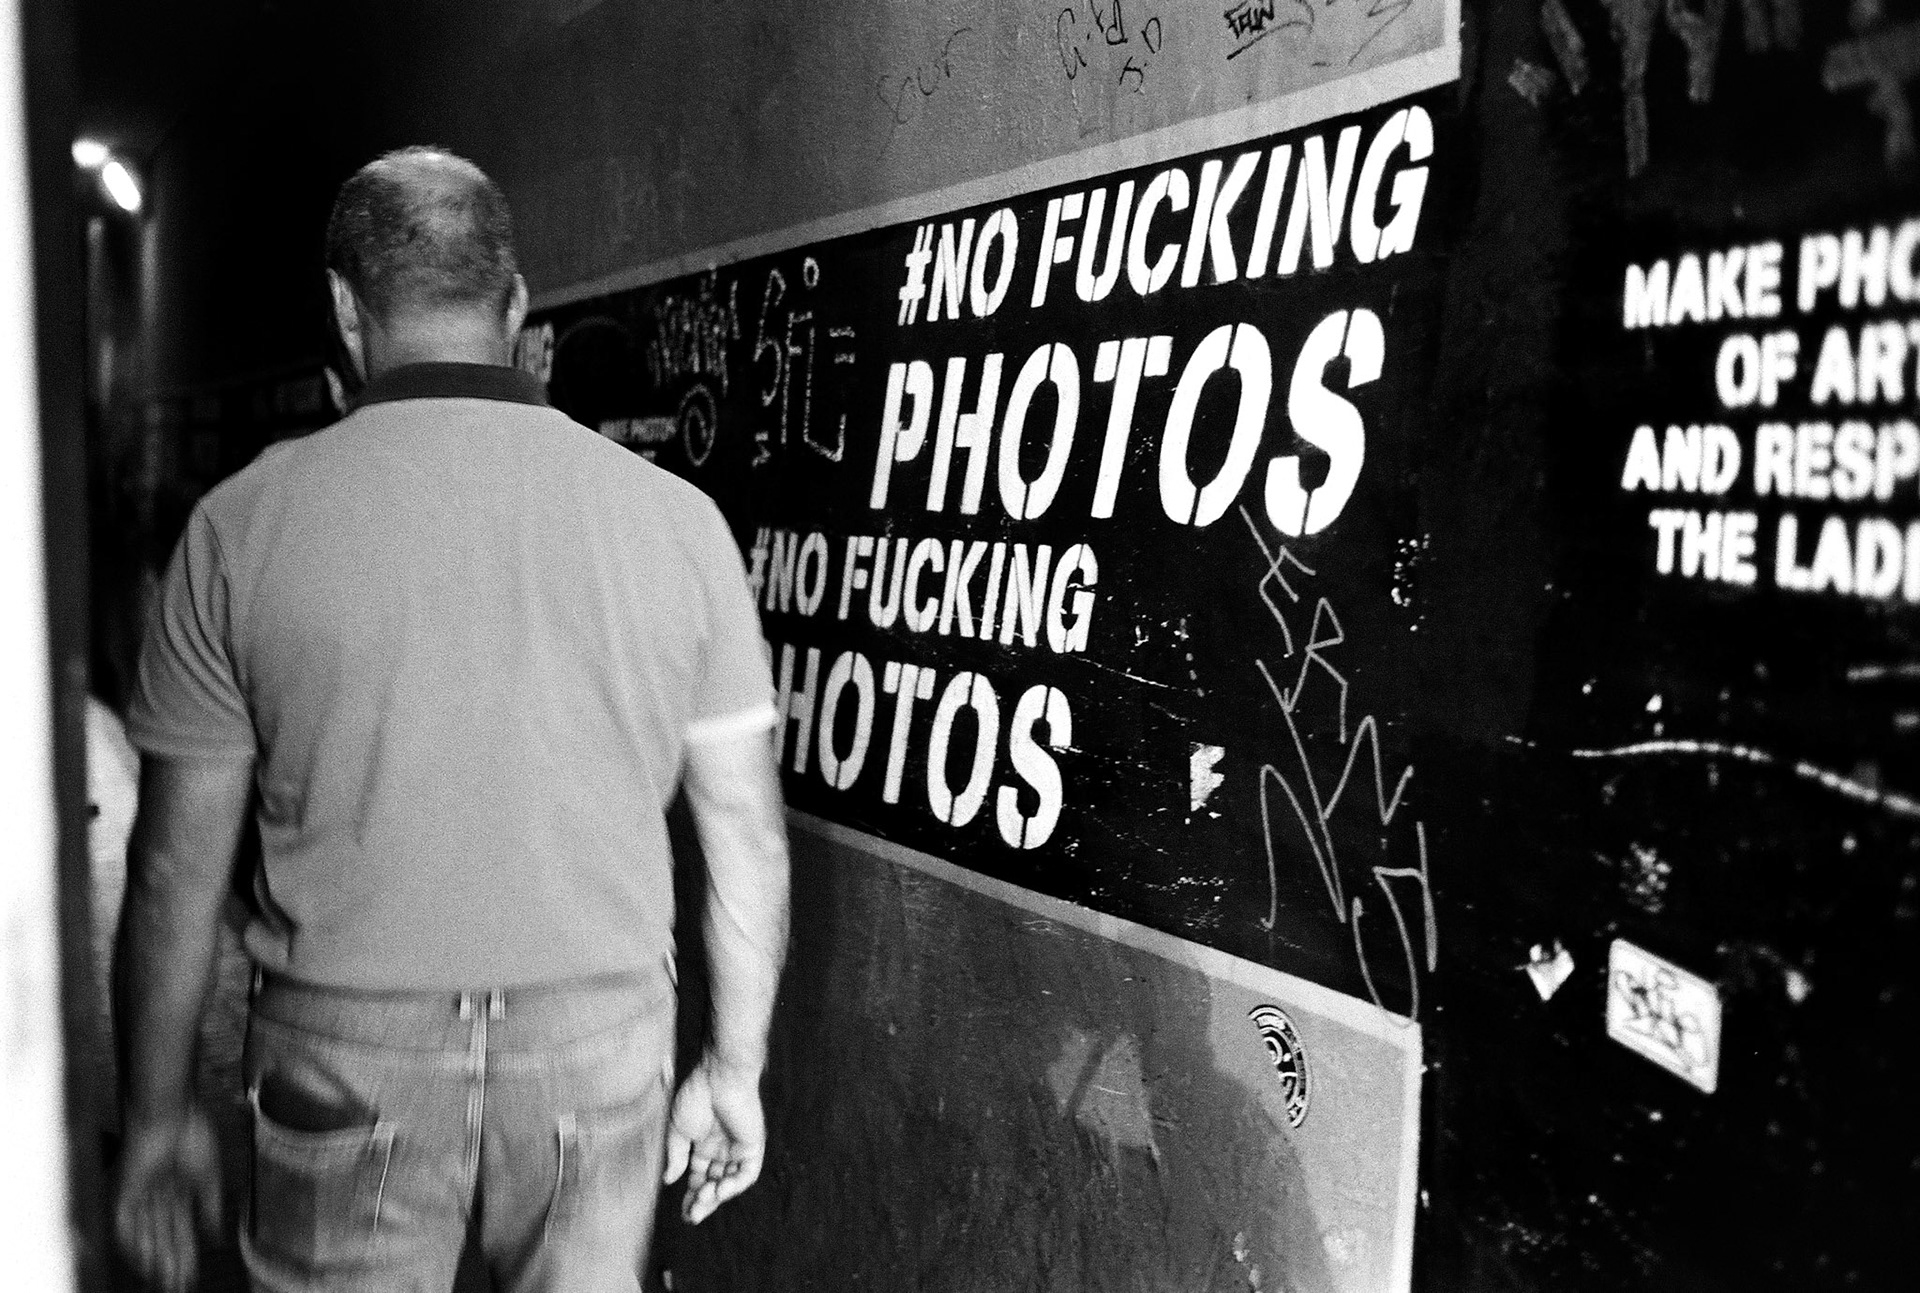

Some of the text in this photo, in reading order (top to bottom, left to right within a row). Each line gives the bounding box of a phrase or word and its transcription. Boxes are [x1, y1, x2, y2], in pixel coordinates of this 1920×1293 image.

[899, 105, 1434, 325] #NO FUCKING
[1622, 241, 1784, 330] MAKE
[1714, 330, 1800, 408] OF
[869, 308, 1385, 537] PHOTOS
[1620, 424, 1742, 495] AND
[837, 535, 1099, 654] FUCKING
[1648, 508, 1758, 587] THE
[773, 642, 1073, 850] HOTOS
